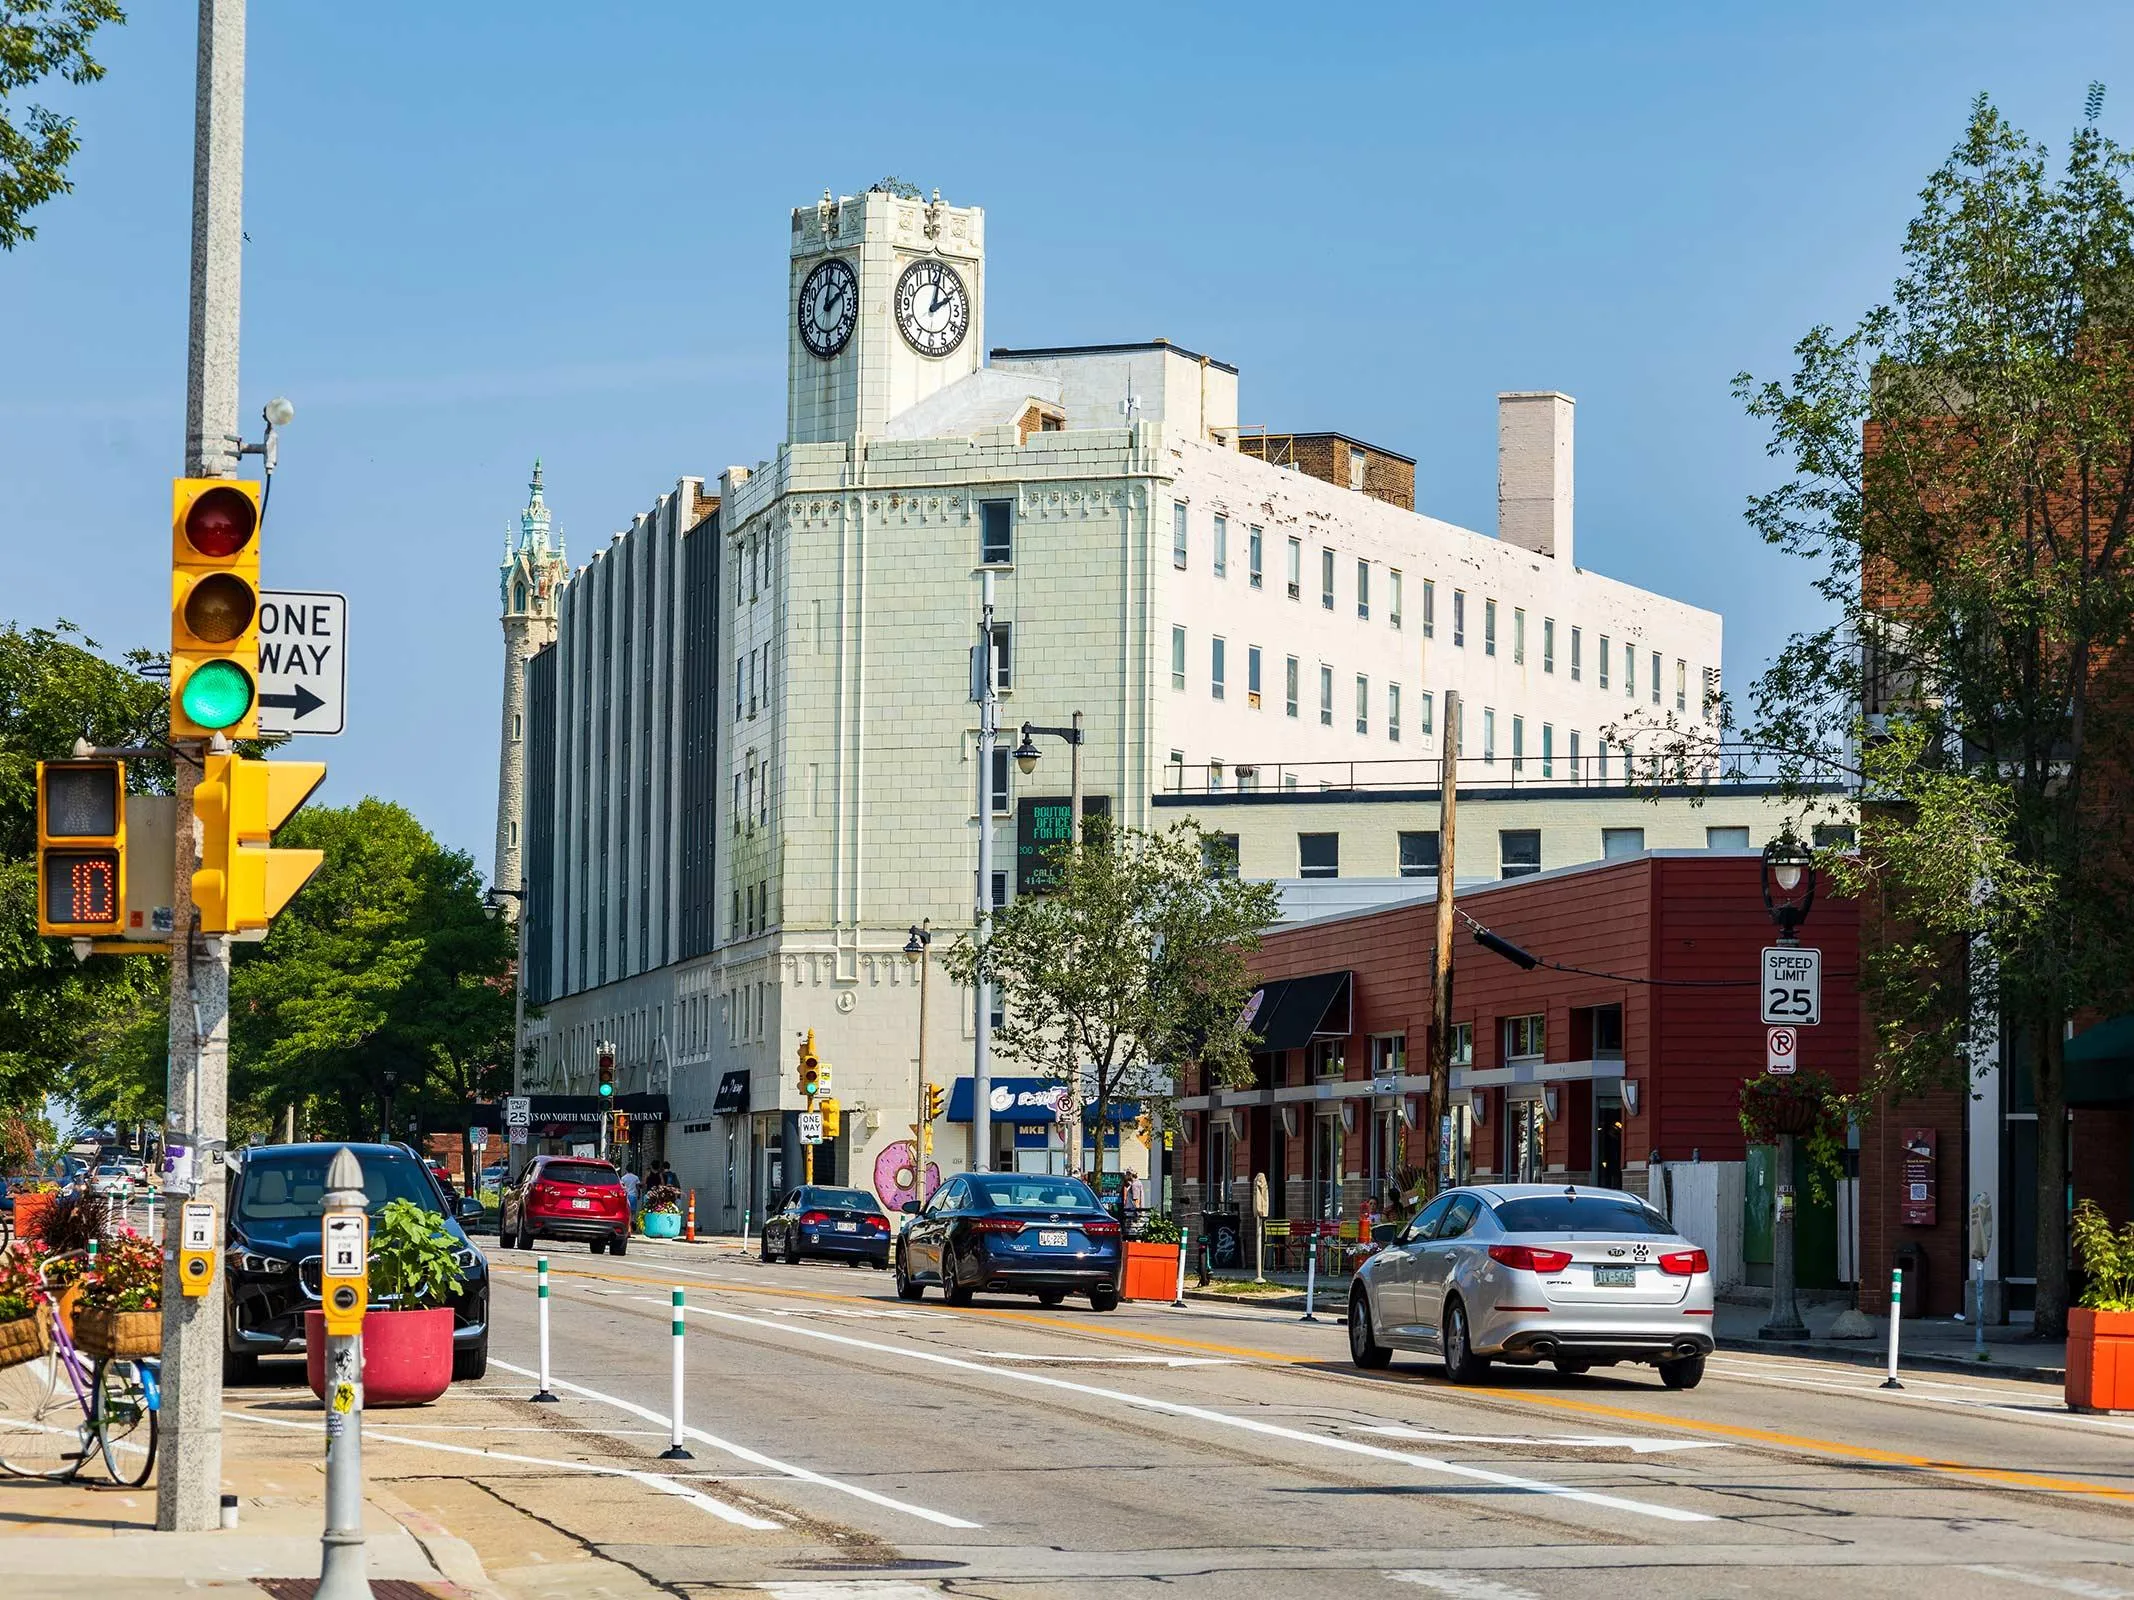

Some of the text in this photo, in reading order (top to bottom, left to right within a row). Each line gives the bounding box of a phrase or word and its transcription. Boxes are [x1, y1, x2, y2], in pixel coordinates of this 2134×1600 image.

[904, 284, 915, 297] 10
[846, 298, 852, 311] 3
[903, 297, 910, 311] 9
[806, 304, 812, 318] 9
[953, 304, 960, 318] 3
[816, 331, 821, 345] 7
[826, 333, 832, 347] 6
[917, 328, 923, 341] 7
[928, 333, 935, 347] 6
[940, 332, 947, 346] 5
[259, 603, 331, 636] ONE
[258, 643, 331, 676] WAY
[1034, 806, 1072, 818] BOUTIQU
[1036, 818, 1072, 828] OFFICE
[1034, 828, 1072, 838] FOR REN
[72, 861, 112, 920] 10
[1769, 956, 1812, 969] SPEED
[1774, 970, 1807, 982] LIMIT
[1769, 988, 1812, 1016] 25
[510, 1112, 527, 1122] 25
[540, 1113, 551, 1121] ON
[552, 1113, 578, 1121] NORTH
[630, 1112, 663, 1121] TAURANT
[1019, 1126, 1045, 1134] MKE
